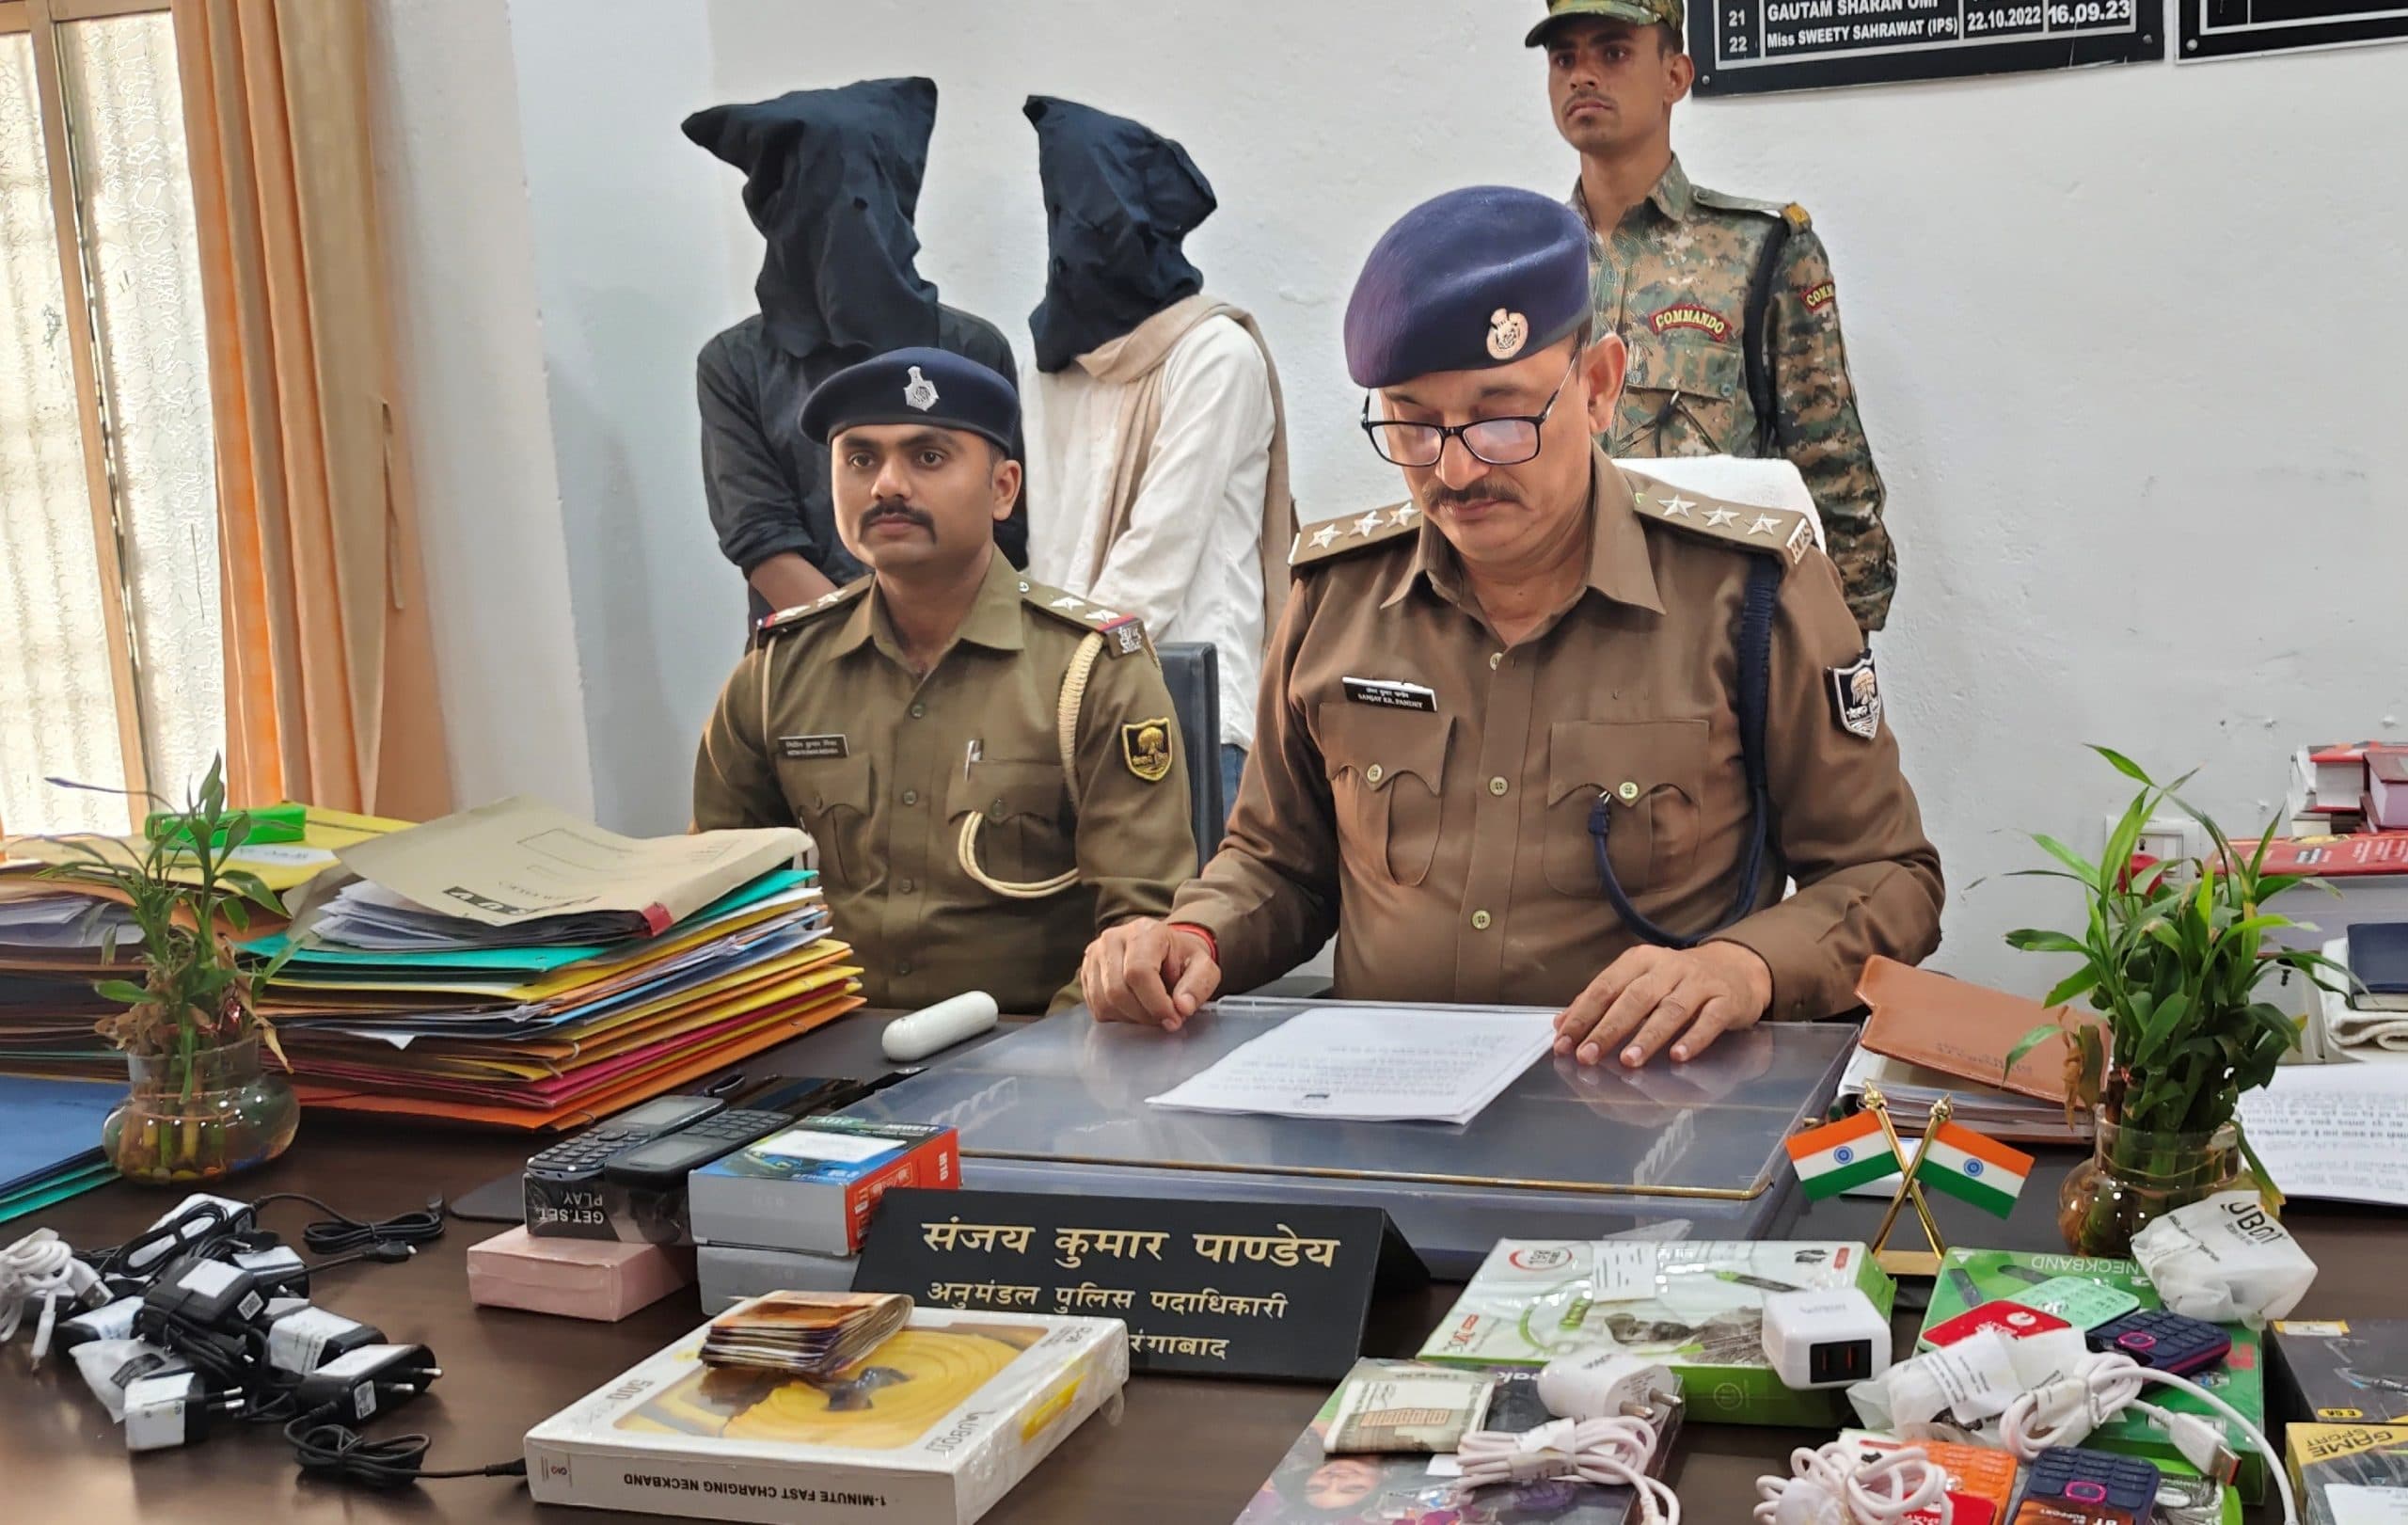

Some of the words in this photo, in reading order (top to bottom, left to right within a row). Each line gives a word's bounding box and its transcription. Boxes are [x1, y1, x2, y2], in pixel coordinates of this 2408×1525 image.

[1728, 10, 1746, 26] 21
[1766, 4, 1832, 22] GAUTAM
[1837, 0, 1904, 16] SHARAN
[1729, 37, 1748, 53] 22
[1766, 32, 1795, 48] Miss
[1798, 26, 1850, 45] SWEETY
[1852, 20, 1925, 40] SAHRAWAT
[1927, 17, 1958, 37] (IPS)
[1967, 6, 2041, 32] 22.10.2022
[2048, 0, 2131, 24] 16.09.23
[1655, 310, 1725, 336] COMMANDO
[921, 1215, 1037, 1255] संजय
[1054, 1226, 1170, 1268] कुमार
[1193, 1223, 1340, 1268] पाण्डेय
[2031, 1256, 2140, 1275] NECKBAND
[927, 1280, 1041, 1310] अनुमंडल
[1054, 1283, 1137, 1314] पुलिस
[1150, 1287, 1288, 1319] पदाधिकारी
[1130, 1332, 1230, 1361] रंगाबाद
[2306, 1428, 2368, 1447] SPORT
[2307, 1430, 2394, 1457] GAME
[624, 1473, 699, 1491] NECKBAND
[704, 1481, 777, 1499] CHARGING
[781, 1487, 816, 1502] FAST
[819, 1490, 887, 1507] 1-MINUTE
